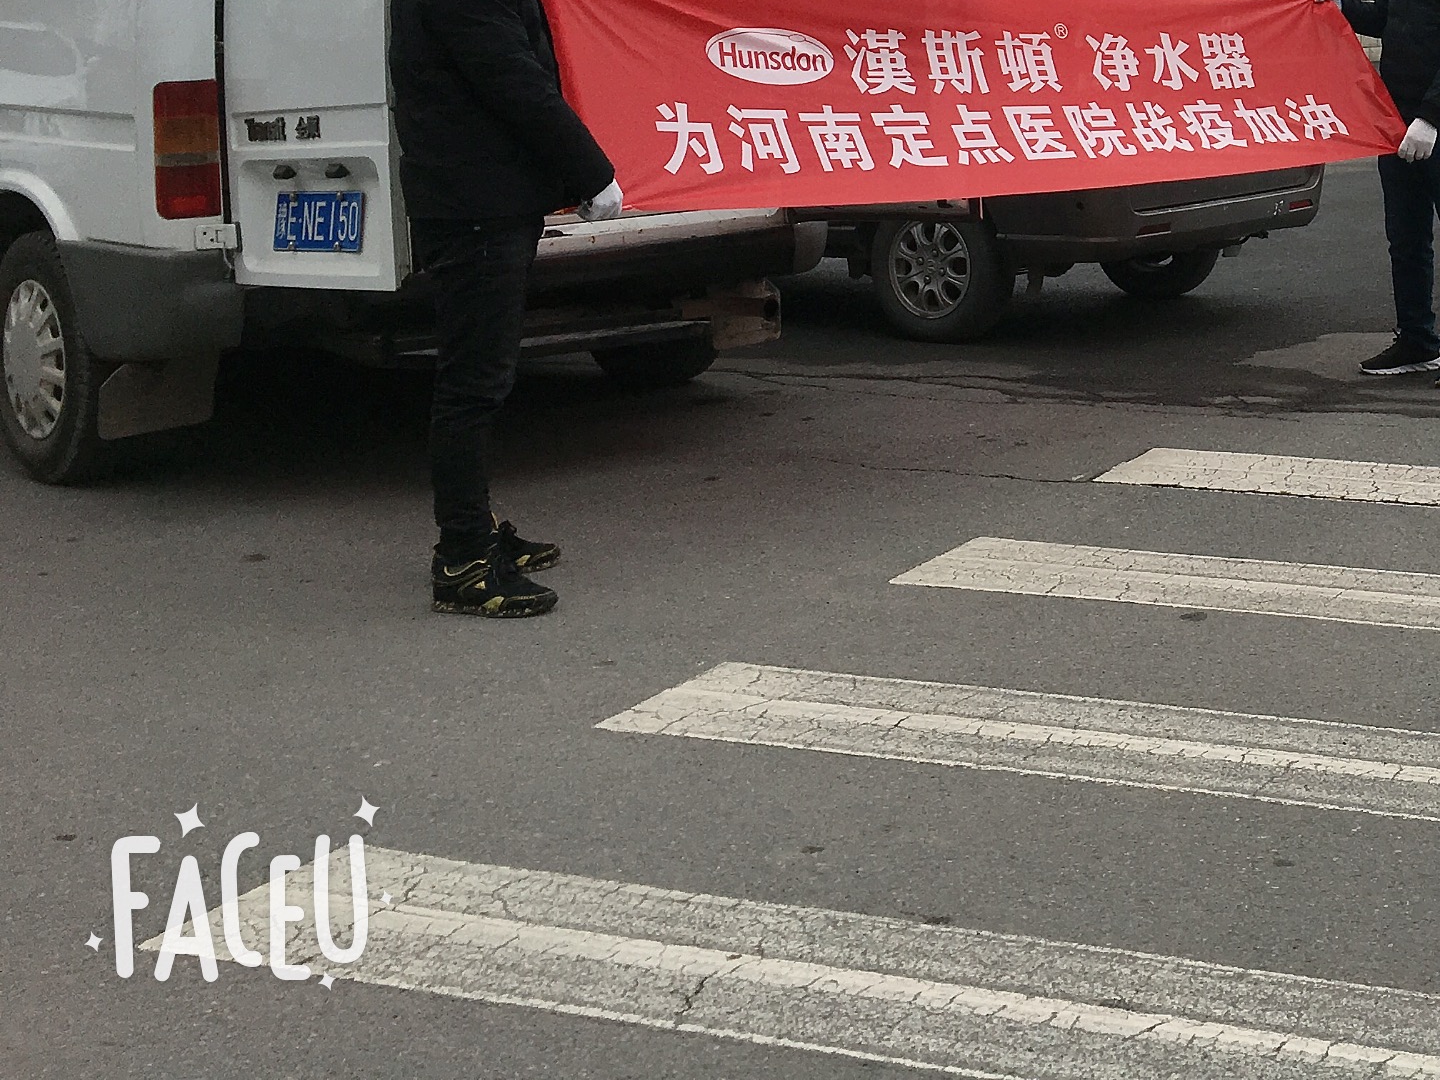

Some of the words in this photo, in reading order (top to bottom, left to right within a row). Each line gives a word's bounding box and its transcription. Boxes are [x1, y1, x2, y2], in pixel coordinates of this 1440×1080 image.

[718, 42, 827, 71] Hunsdon
[1085, 31, 1257, 92] 净水器
[655, 96, 1350, 177] 为河南定点医院战疫加油
